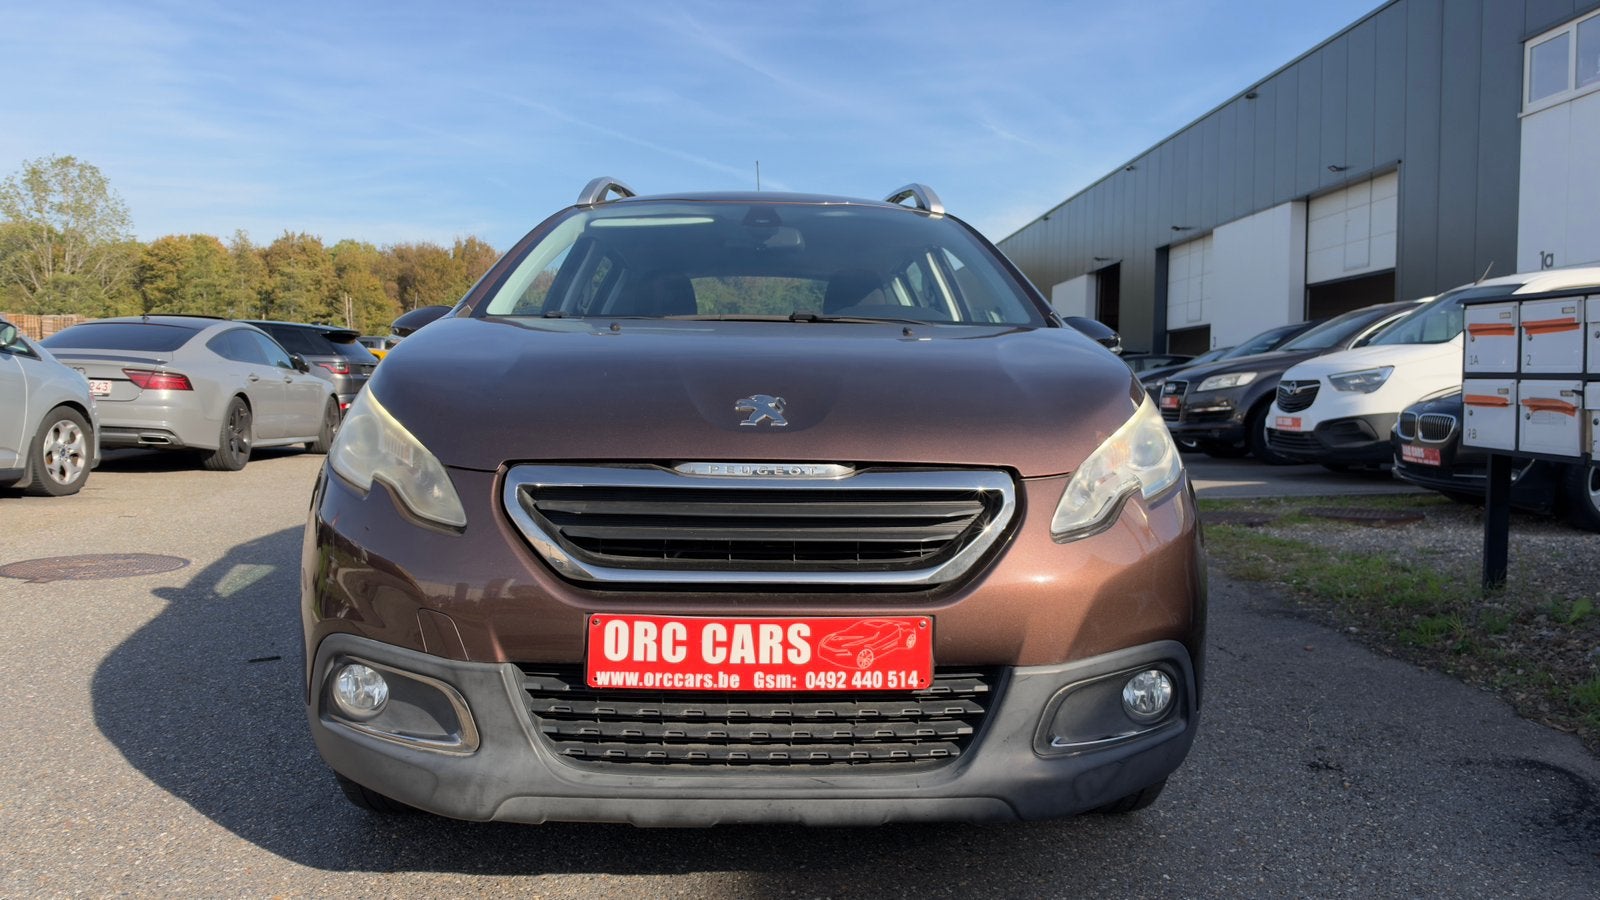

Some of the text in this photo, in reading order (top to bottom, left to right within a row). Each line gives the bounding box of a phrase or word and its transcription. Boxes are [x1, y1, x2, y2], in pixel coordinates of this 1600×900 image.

[1539, 251, 1554, 271] 1a
[1526, 355, 1531, 366] 2
[708, 465, 818, 476] PEUGEOT
[603, 619, 811, 665] ORC CARS
[596, 670, 918, 689] www.orccars.be Gsm: 0492 440 514
